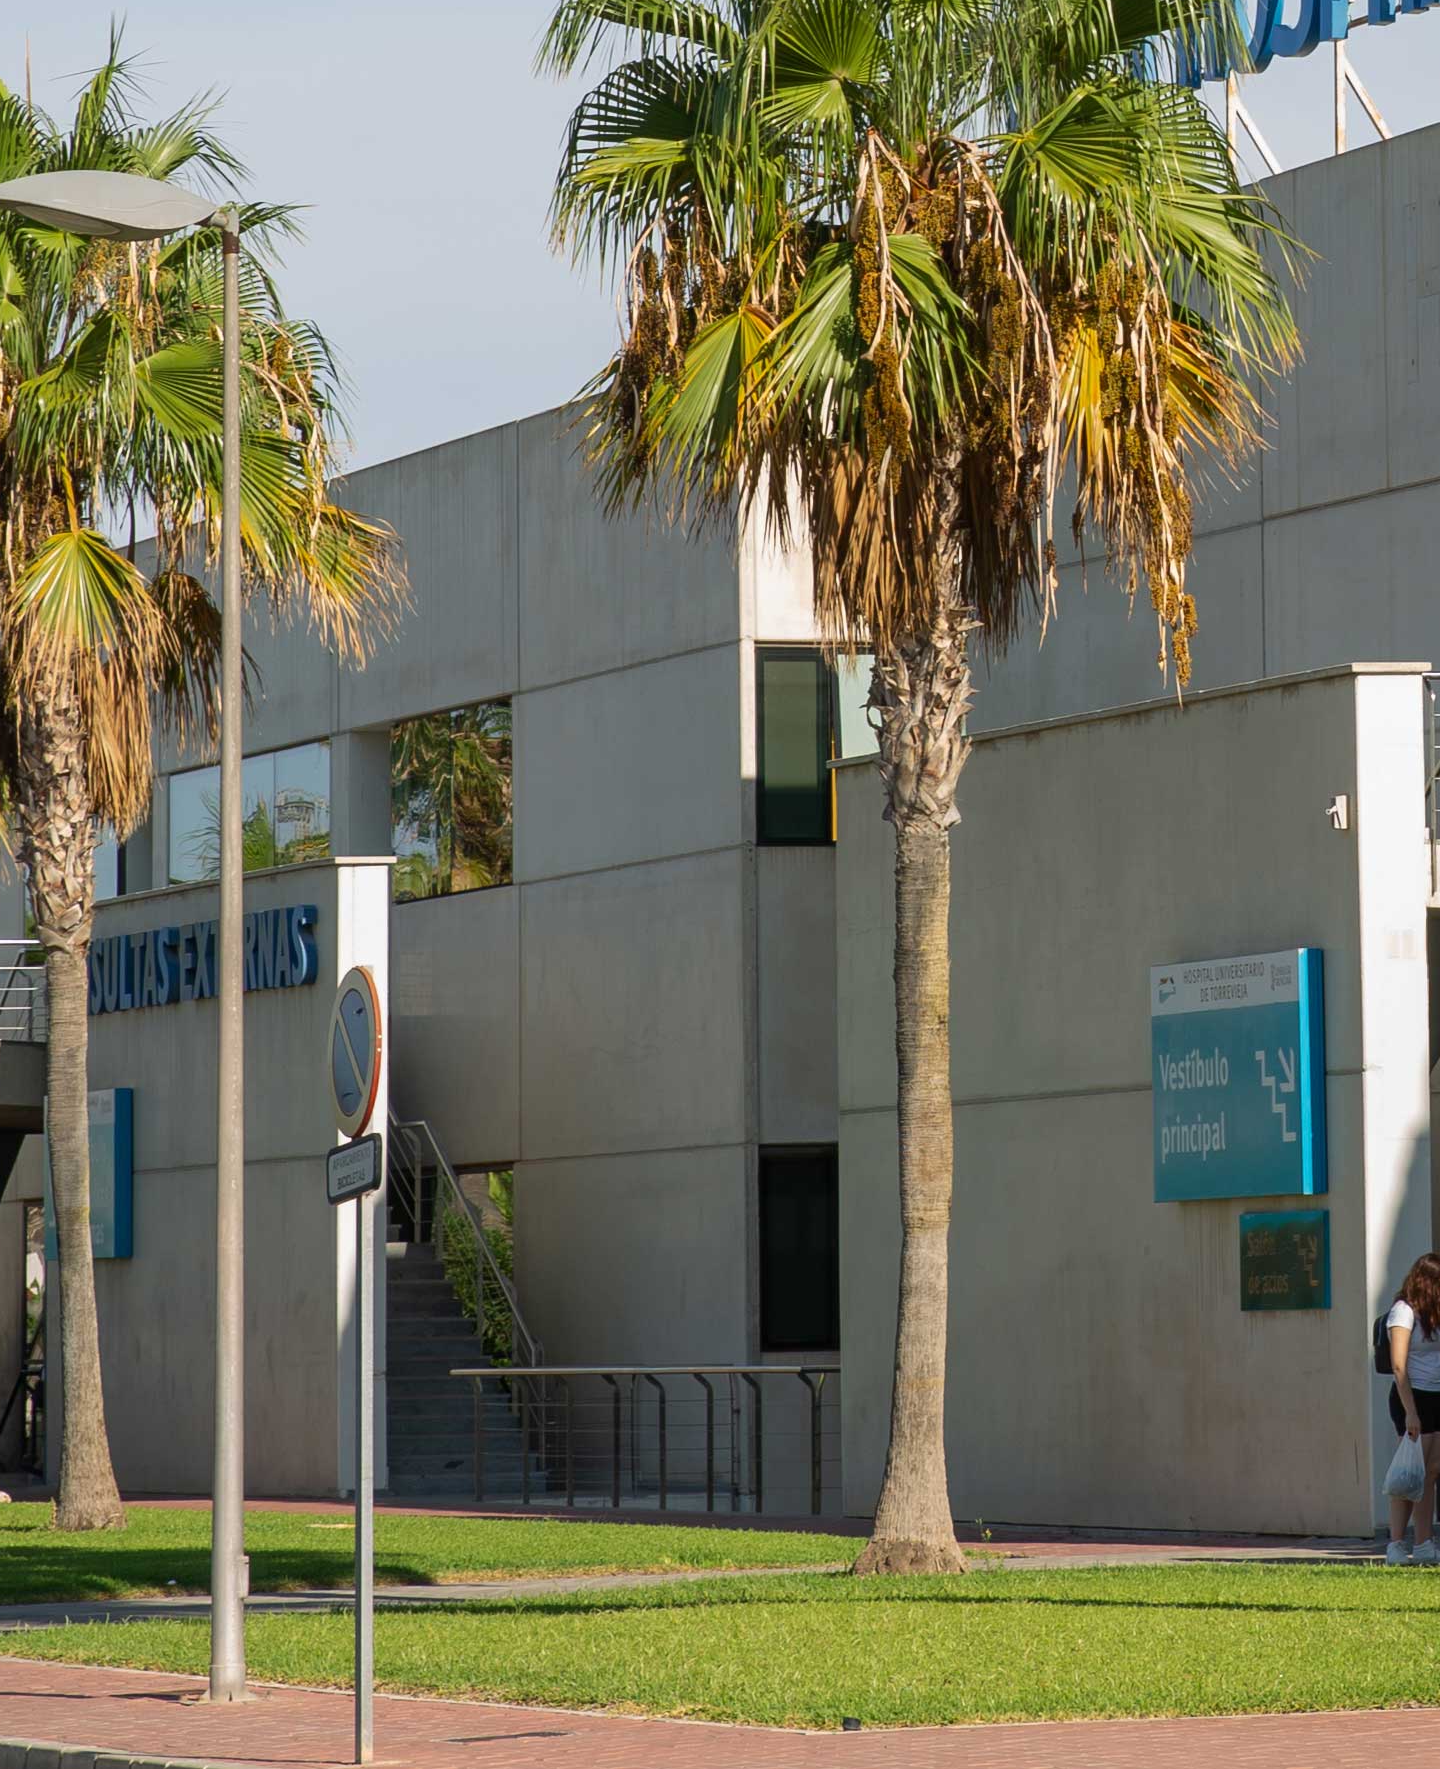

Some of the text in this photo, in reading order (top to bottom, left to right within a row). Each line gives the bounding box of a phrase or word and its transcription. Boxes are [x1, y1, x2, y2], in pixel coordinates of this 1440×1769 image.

[88, 904, 318, 1016] SULTAS EXTRNAS
[1159, 1047, 1229, 1091] Vestíbulo
[1161, 1111, 1227, 1164] principal
